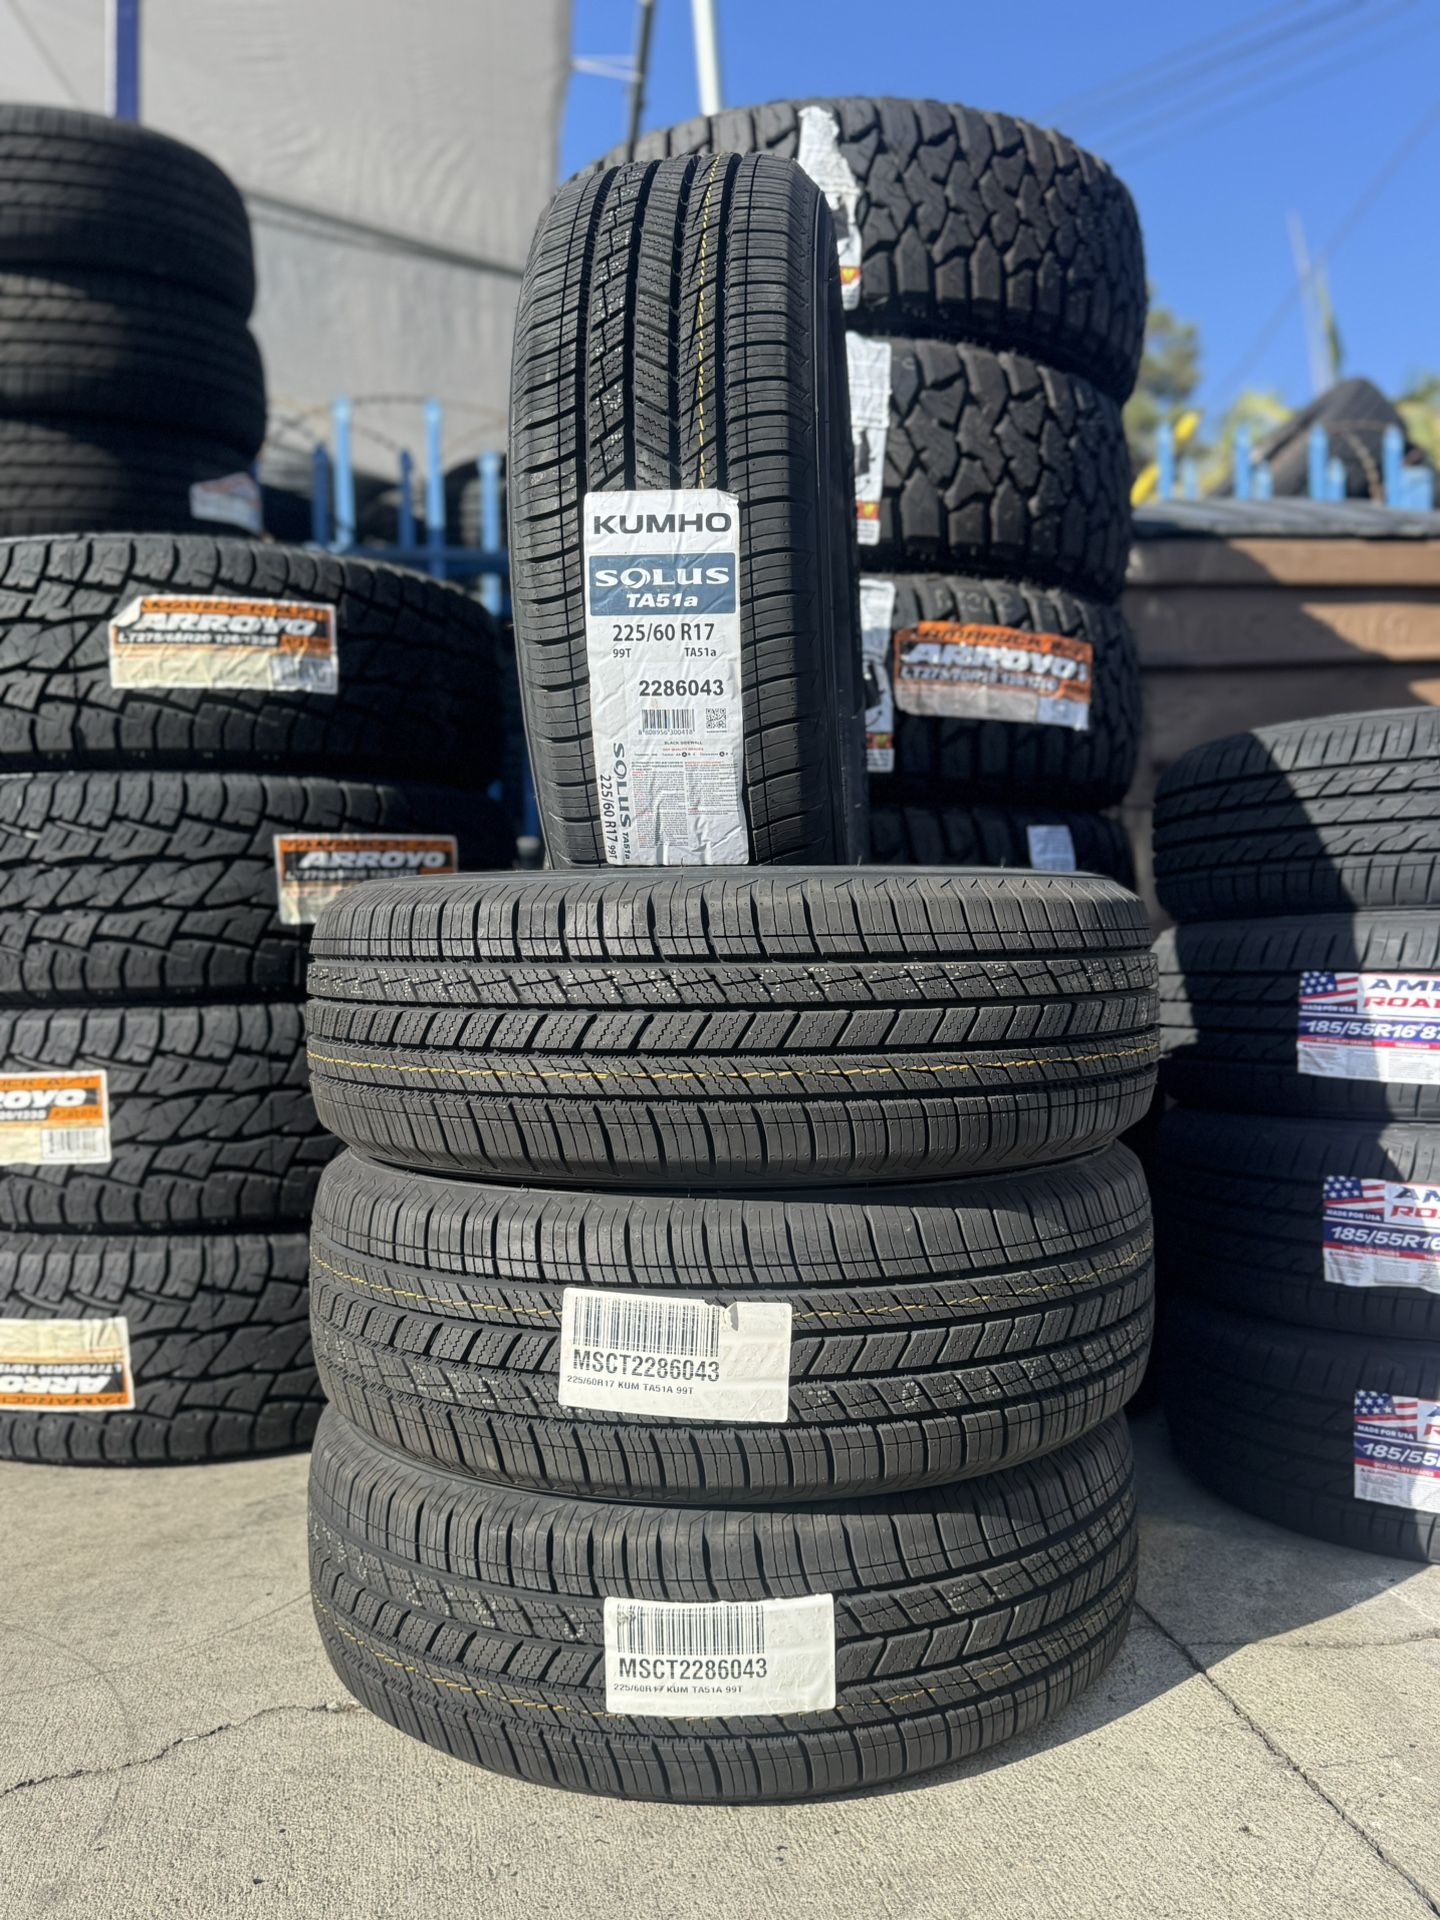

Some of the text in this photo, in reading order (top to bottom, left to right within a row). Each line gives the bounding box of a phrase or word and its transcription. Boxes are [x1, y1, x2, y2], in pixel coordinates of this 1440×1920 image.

[593, 512, 732, 535] KUMHO
[595, 567, 730, 589] SOLUS
[626, 593, 699, 608] TA51a
[132, 613, 317, 636] ARROYO
[612, 623, 715, 642] 225/60 R17
[612, 647, 717, 658] 99T TA51a
[901, 642, 1079, 680] ARROYO
[639, 679, 724, 697] 2286043
[613, 742, 632, 828] SOLUS
[600, 774, 618, 860] 225/60 R17 99T
[299, 851, 446, 869] ARROYO
[0, 1090, 87, 1109] OYO
[1348, 1211, 1363, 1219] FOR
[1364, 1213, 1381, 1221] USA
[1391, 1205, 1440, 1218] RO
[573, 1348, 720, 1382] MSCT2286043
[567, 1374, 694, 1395] 225/60R17 KUM TA51A 99T
[1357, 1425, 1414, 1441] MADE FOR USA
[1363, 1442, 1440, 1467] 185/55
[619, 1657, 768, 1680] MSCT2286043
[666, 1684, 689, 1694] KUM
[692, 1685, 723, 1694] TA51A
[725, 1684, 743, 1694] 99T
